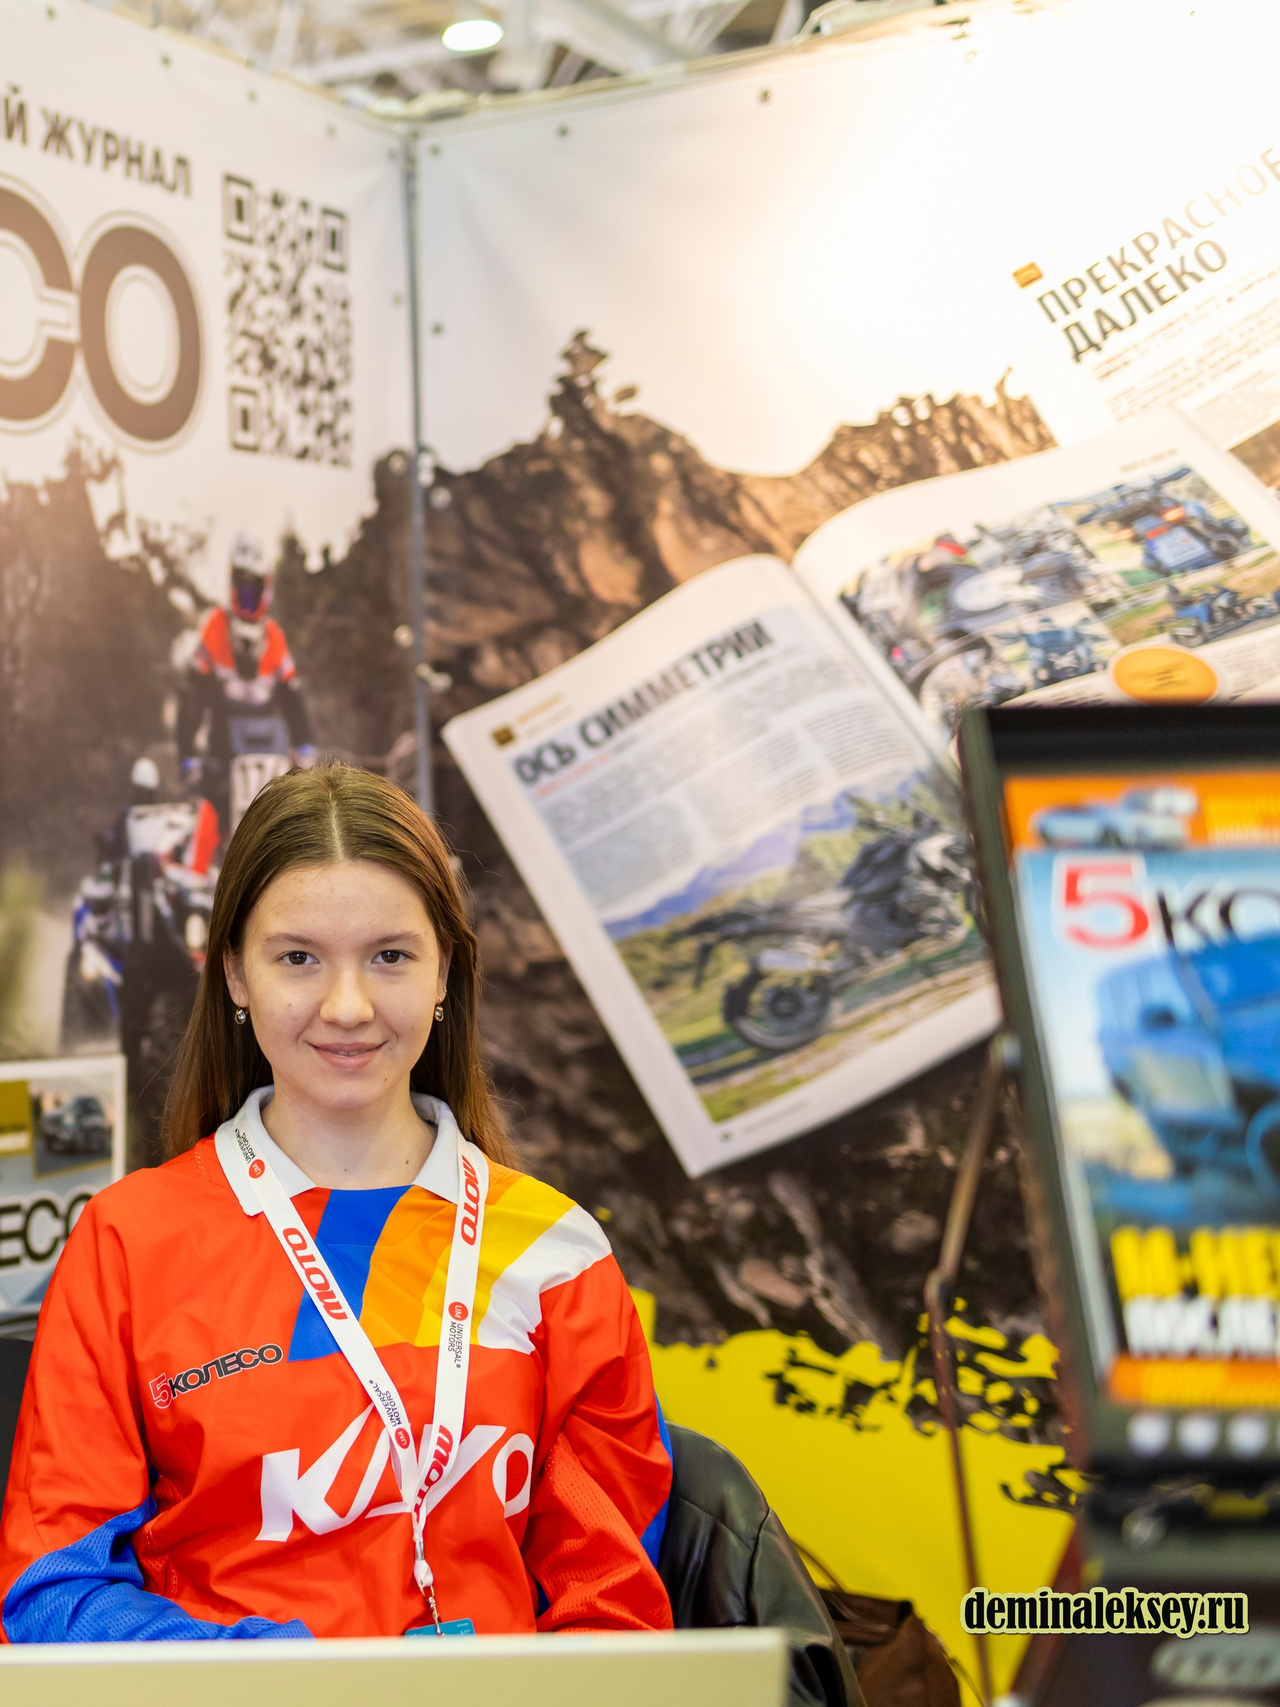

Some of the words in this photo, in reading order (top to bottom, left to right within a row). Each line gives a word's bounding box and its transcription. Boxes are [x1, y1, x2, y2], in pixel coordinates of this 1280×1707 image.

[40, 107, 192, 198] ЖУРНАЛ
[1036, 147, 1280, 324] ПРЕКРАСНОЕ
[1062, 239, 1228, 363] ДАЛЕКО
[514, 740, 576, 785] ОСЬ
[578, 620, 773, 749] СИММЕТРИИ
[460, 1154, 481, 1246] MOTO
[282, 1227, 349, 1321] MOTO
[149, 1343, 284, 1410] 5КОЛЕСО
[447, 1321, 458, 1352] MOTORS
[385, 1390, 403, 1426] MOTORS
